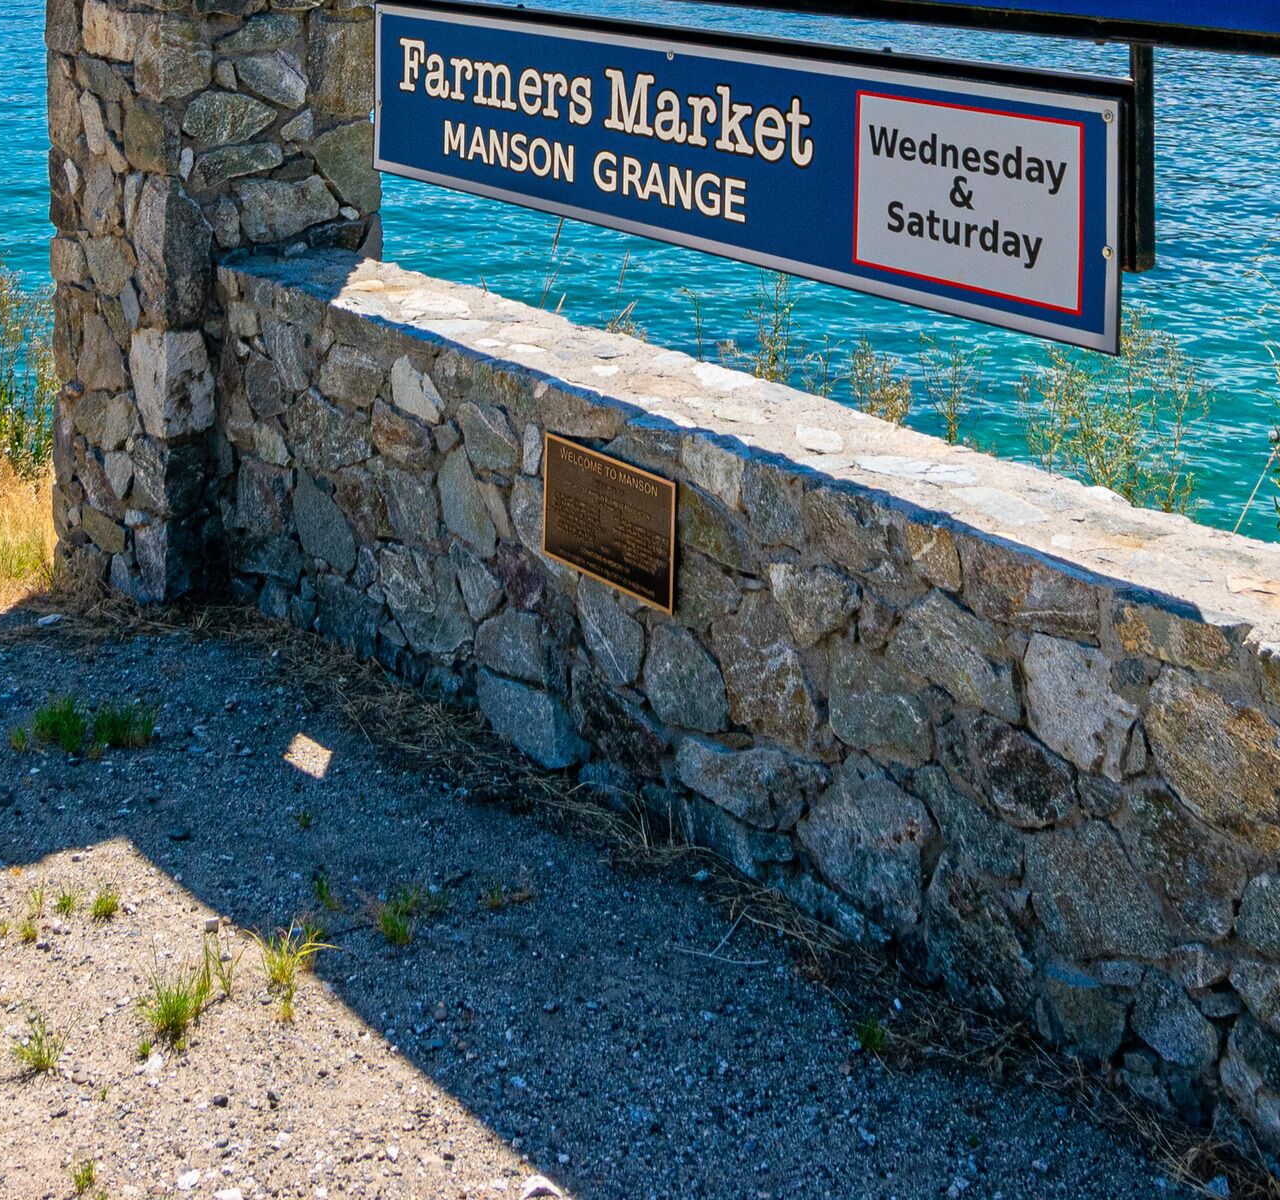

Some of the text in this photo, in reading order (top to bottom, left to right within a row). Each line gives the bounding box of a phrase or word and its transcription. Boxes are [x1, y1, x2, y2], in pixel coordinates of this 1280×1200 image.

[398, 37, 814, 169] Farmers Market
[442, 120, 747, 224] MANSON GRANGE
[867, 124, 1067, 196] Wednesday
[949, 177, 975, 210] &
[886, 200, 1044, 269] Saturday
[560, 447, 603, 474] WELCOME
[605, 466, 617, 480] TO
[619, 472, 658, 497] MANSON
